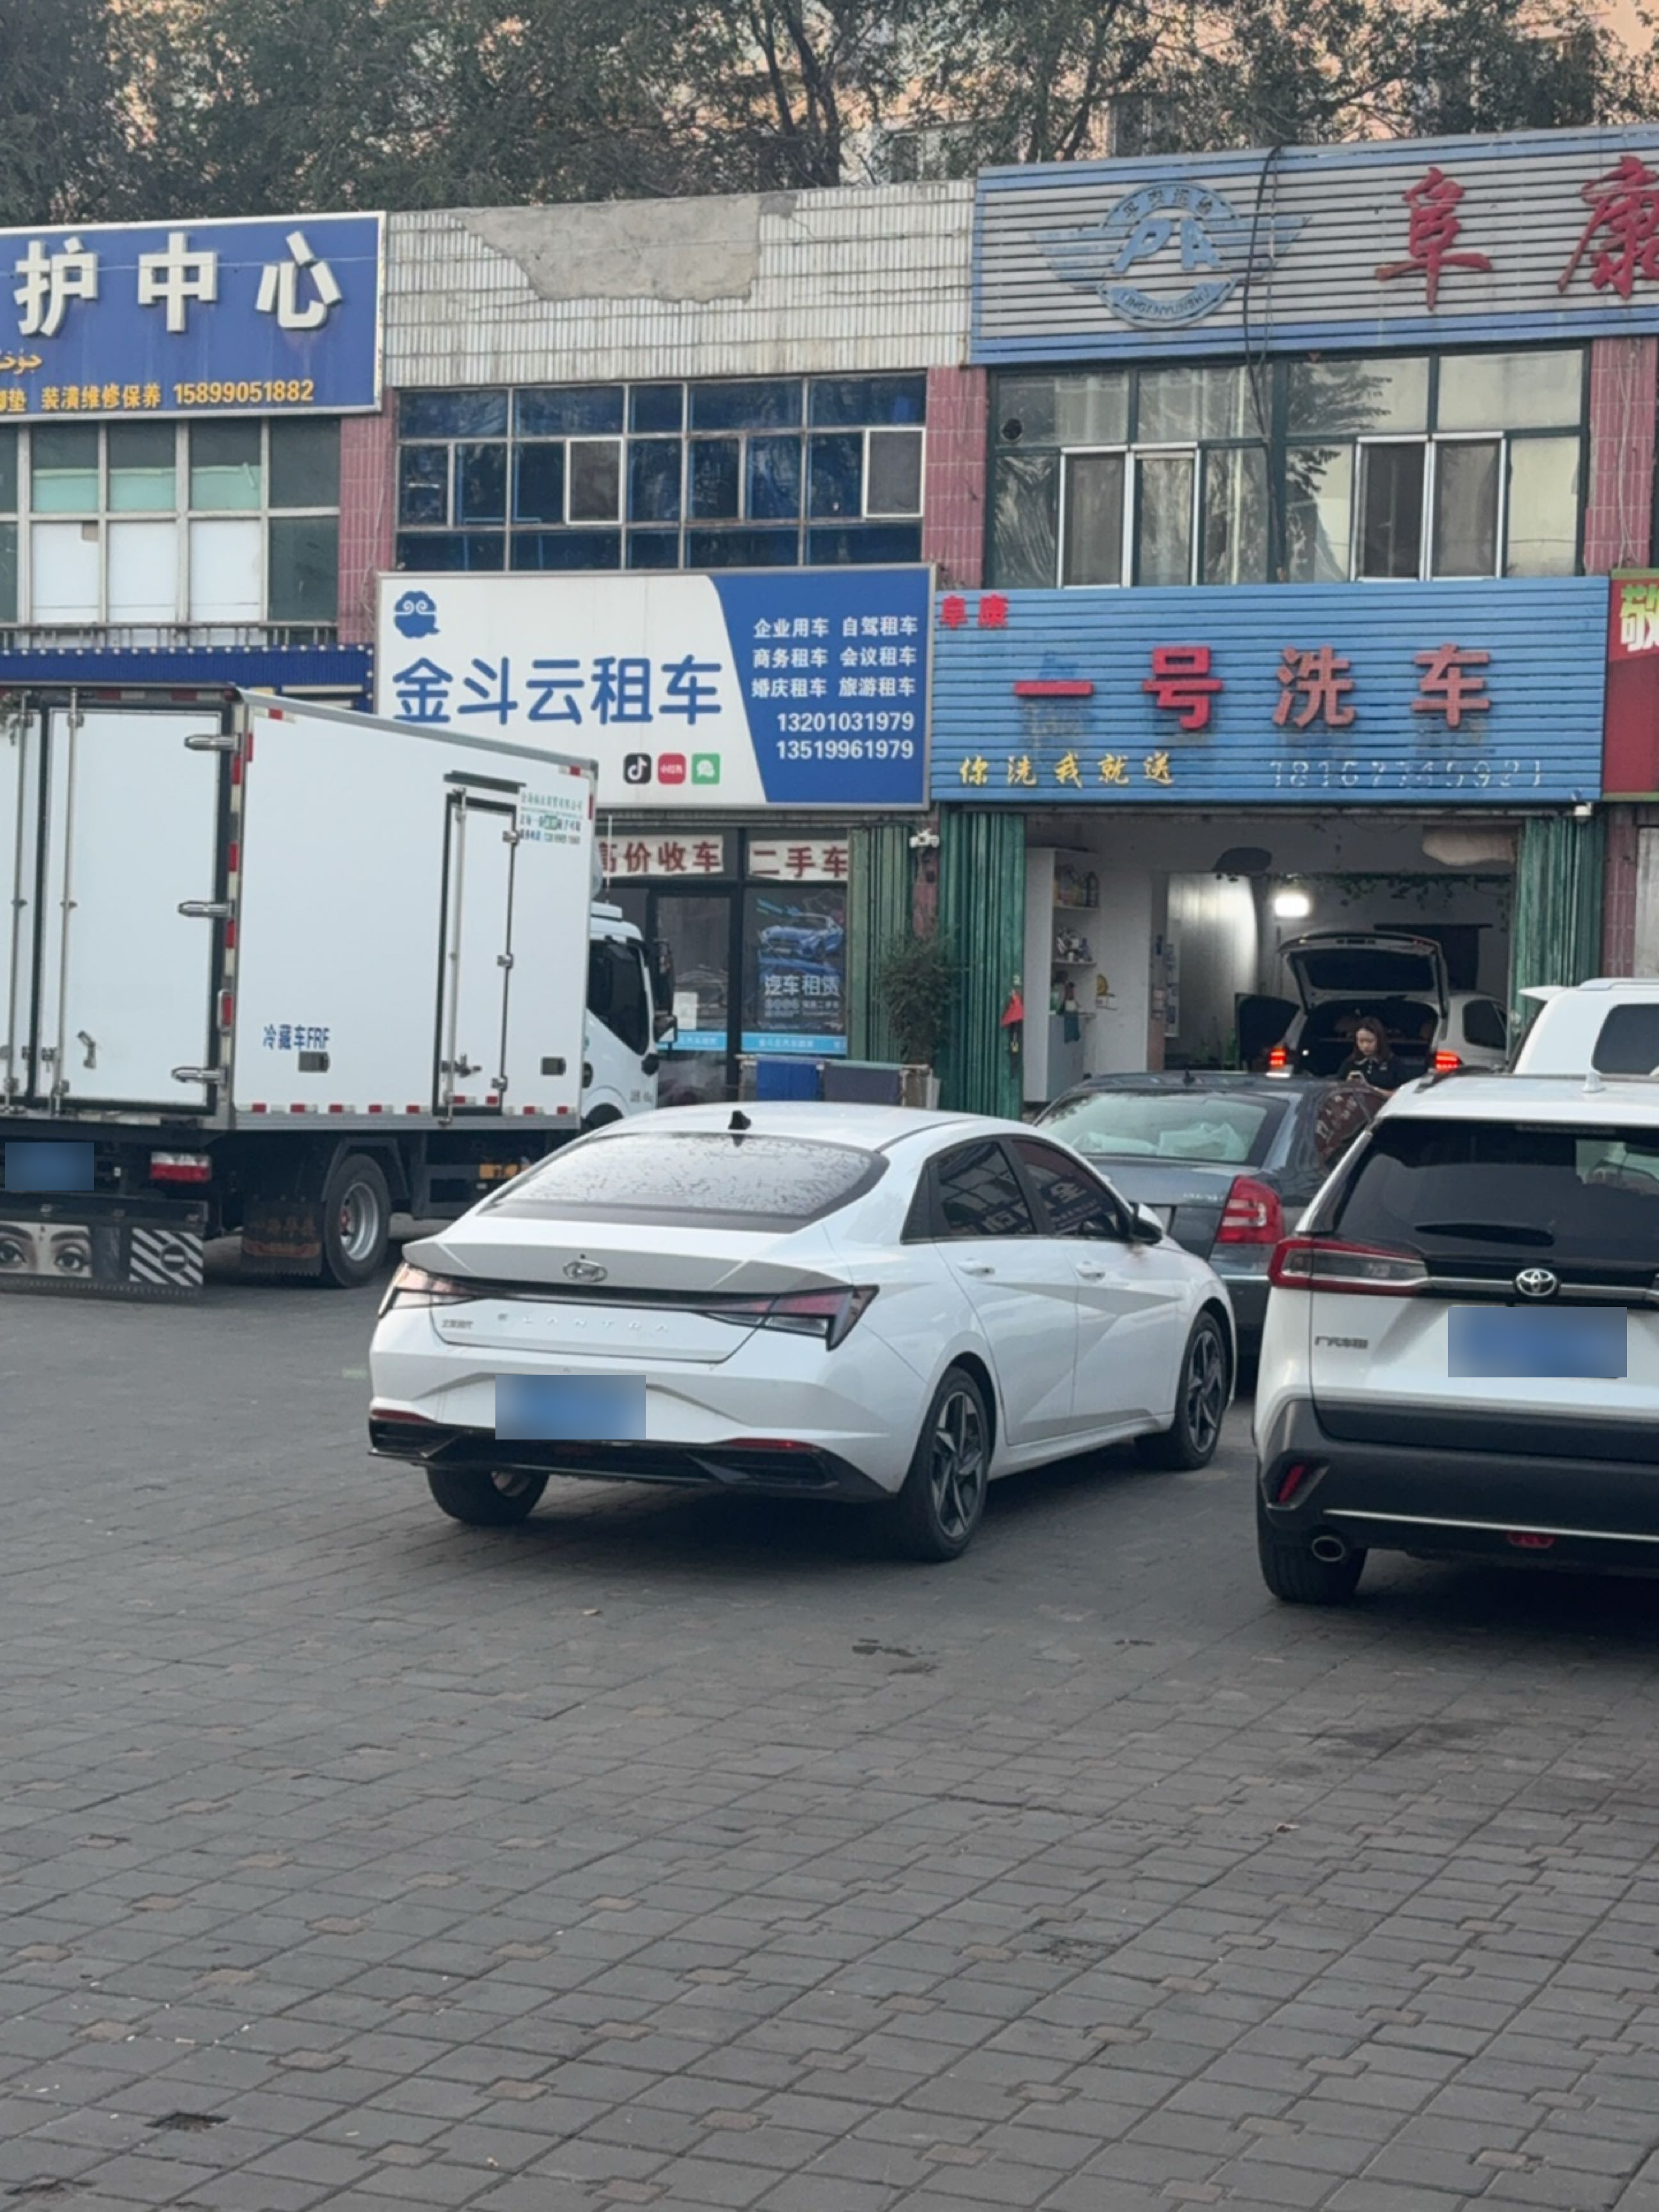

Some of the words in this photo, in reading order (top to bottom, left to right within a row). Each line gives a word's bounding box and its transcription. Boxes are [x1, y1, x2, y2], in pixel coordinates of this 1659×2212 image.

[13, 230, 342, 337] 护中心
[173, 381, 314, 405] 15899051882
[753, 617, 830, 638] 企业用车
[842, 615, 918, 637] 自驾租车
[940, 595, 1008, 630] 阜康
[752, 647, 828, 668] 商务租车
[839, 646, 917, 667] 会议租车
[392, 654, 722, 726] 金斗云租车
[751, 677, 828, 698] 婚庆租车
[838, 676, 916, 697] 旅游租车
[1013, 644, 1493, 729] 一号洗车
[777, 712, 915, 732] 13201031979
[776, 739, 914, 760] 13519961979
[959, 750, 1174, 788] 你洗我就送
[598, 841, 721, 872] 高价收车
[752, 846, 847, 878] 二手车
